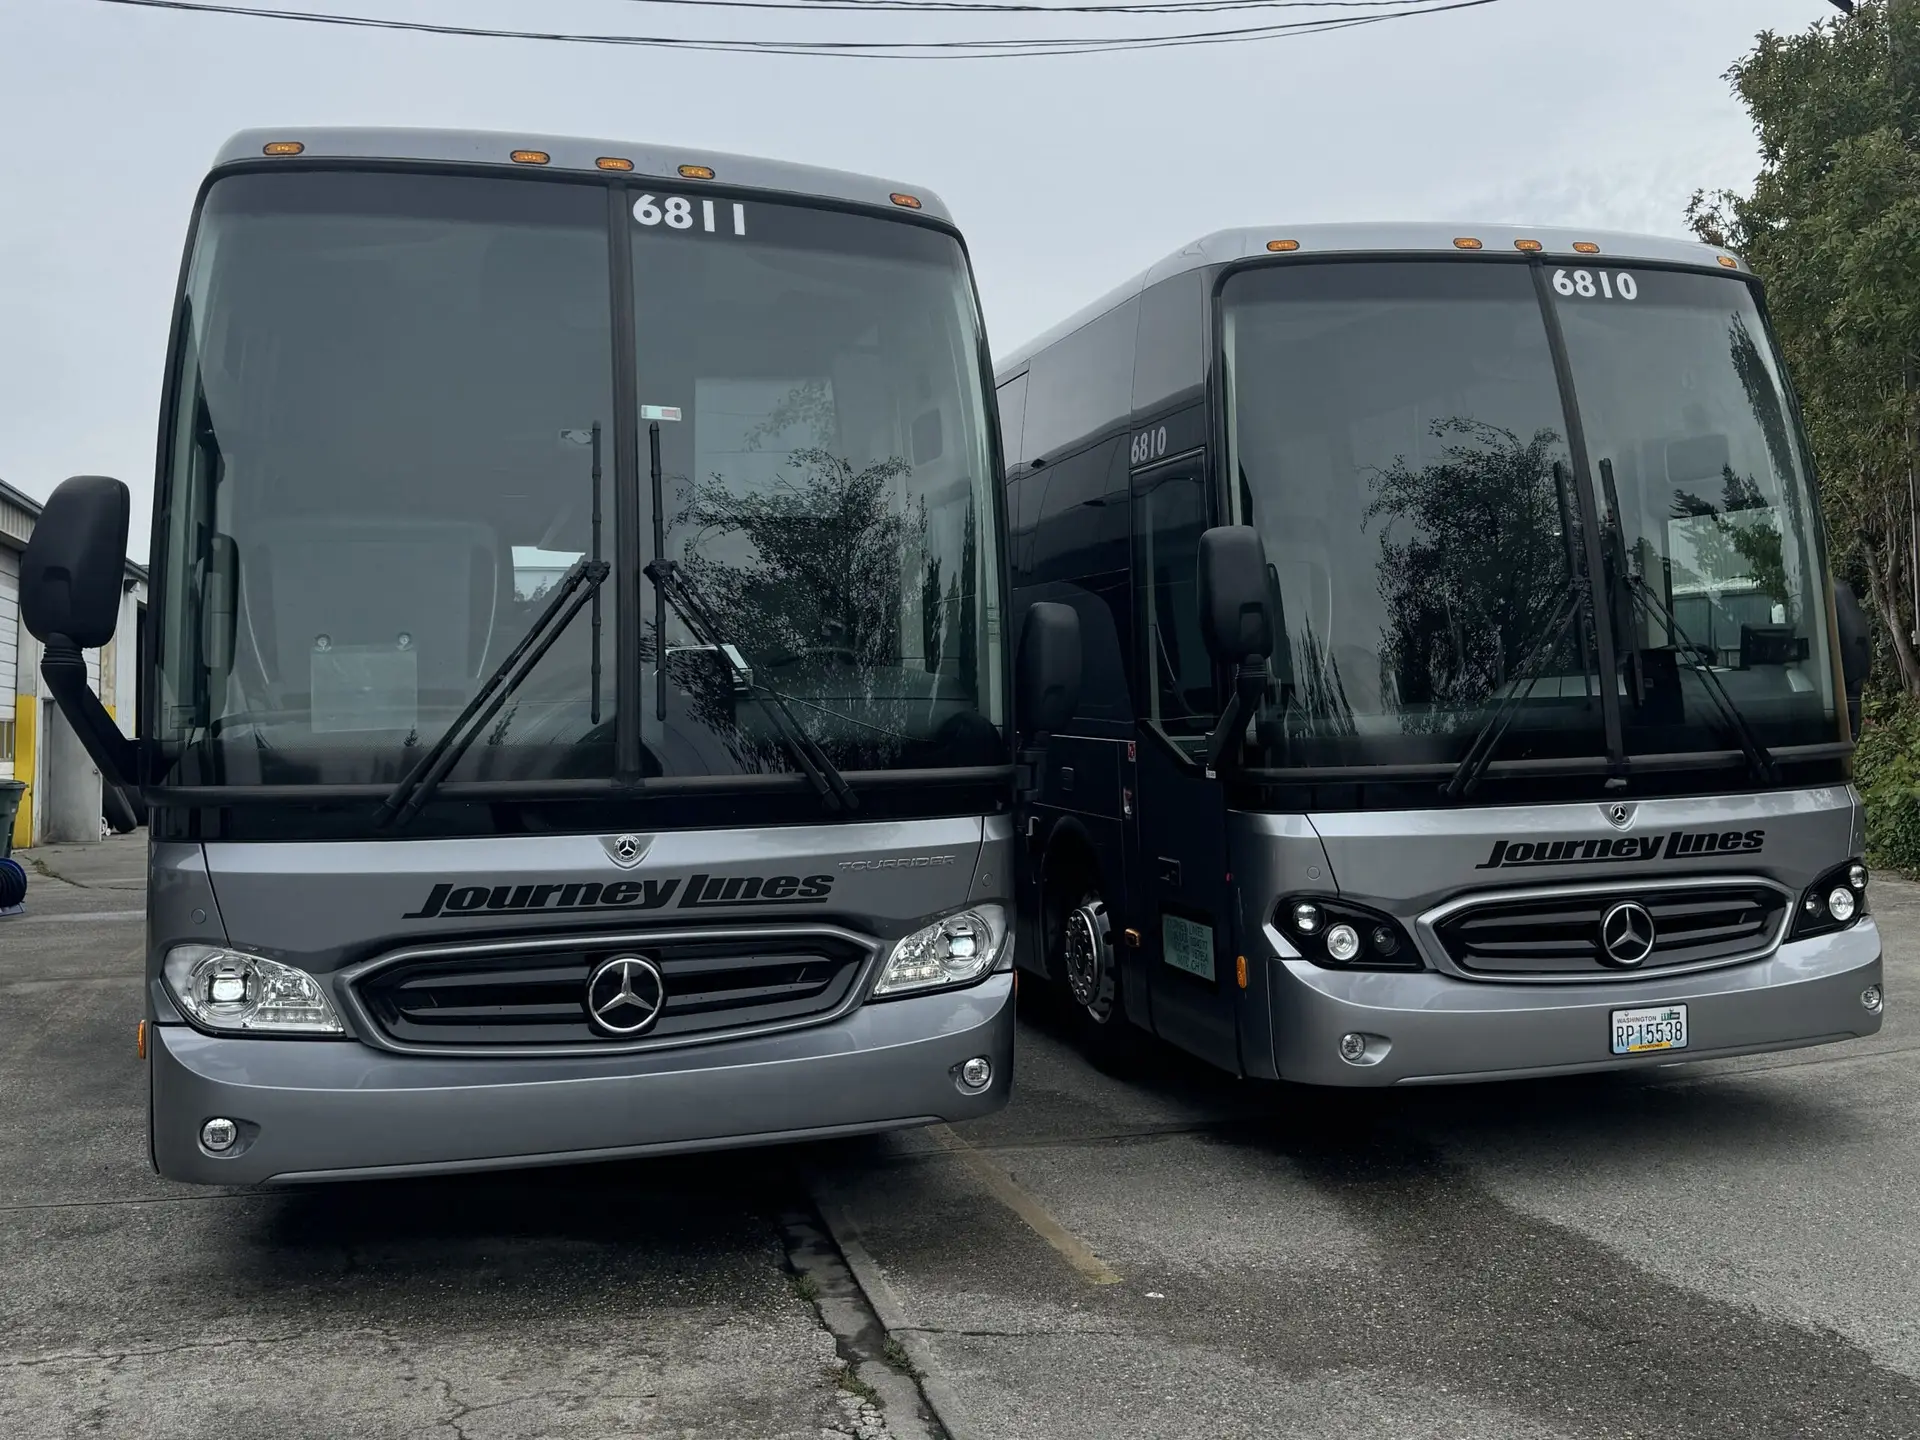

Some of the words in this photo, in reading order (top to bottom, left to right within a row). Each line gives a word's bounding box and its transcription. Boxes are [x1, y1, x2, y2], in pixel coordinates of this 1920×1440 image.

[632, 193, 746, 236] 6811
[1552, 268, 1638, 301] 6810
[1131, 425, 1167, 465] 6810
[838, 855, 956, 872] TOURRIDER
[1475, 835, 1665, 869] Journey
[1663, 829, 1766, 860] Lines
[402, 878, 682, 920] Journey
[677, 873, 835, 909] Lines
[1616, 1015, 1657, 1024] WASHINGTON
[1616, 1020, 1683, 1048] RP15538
